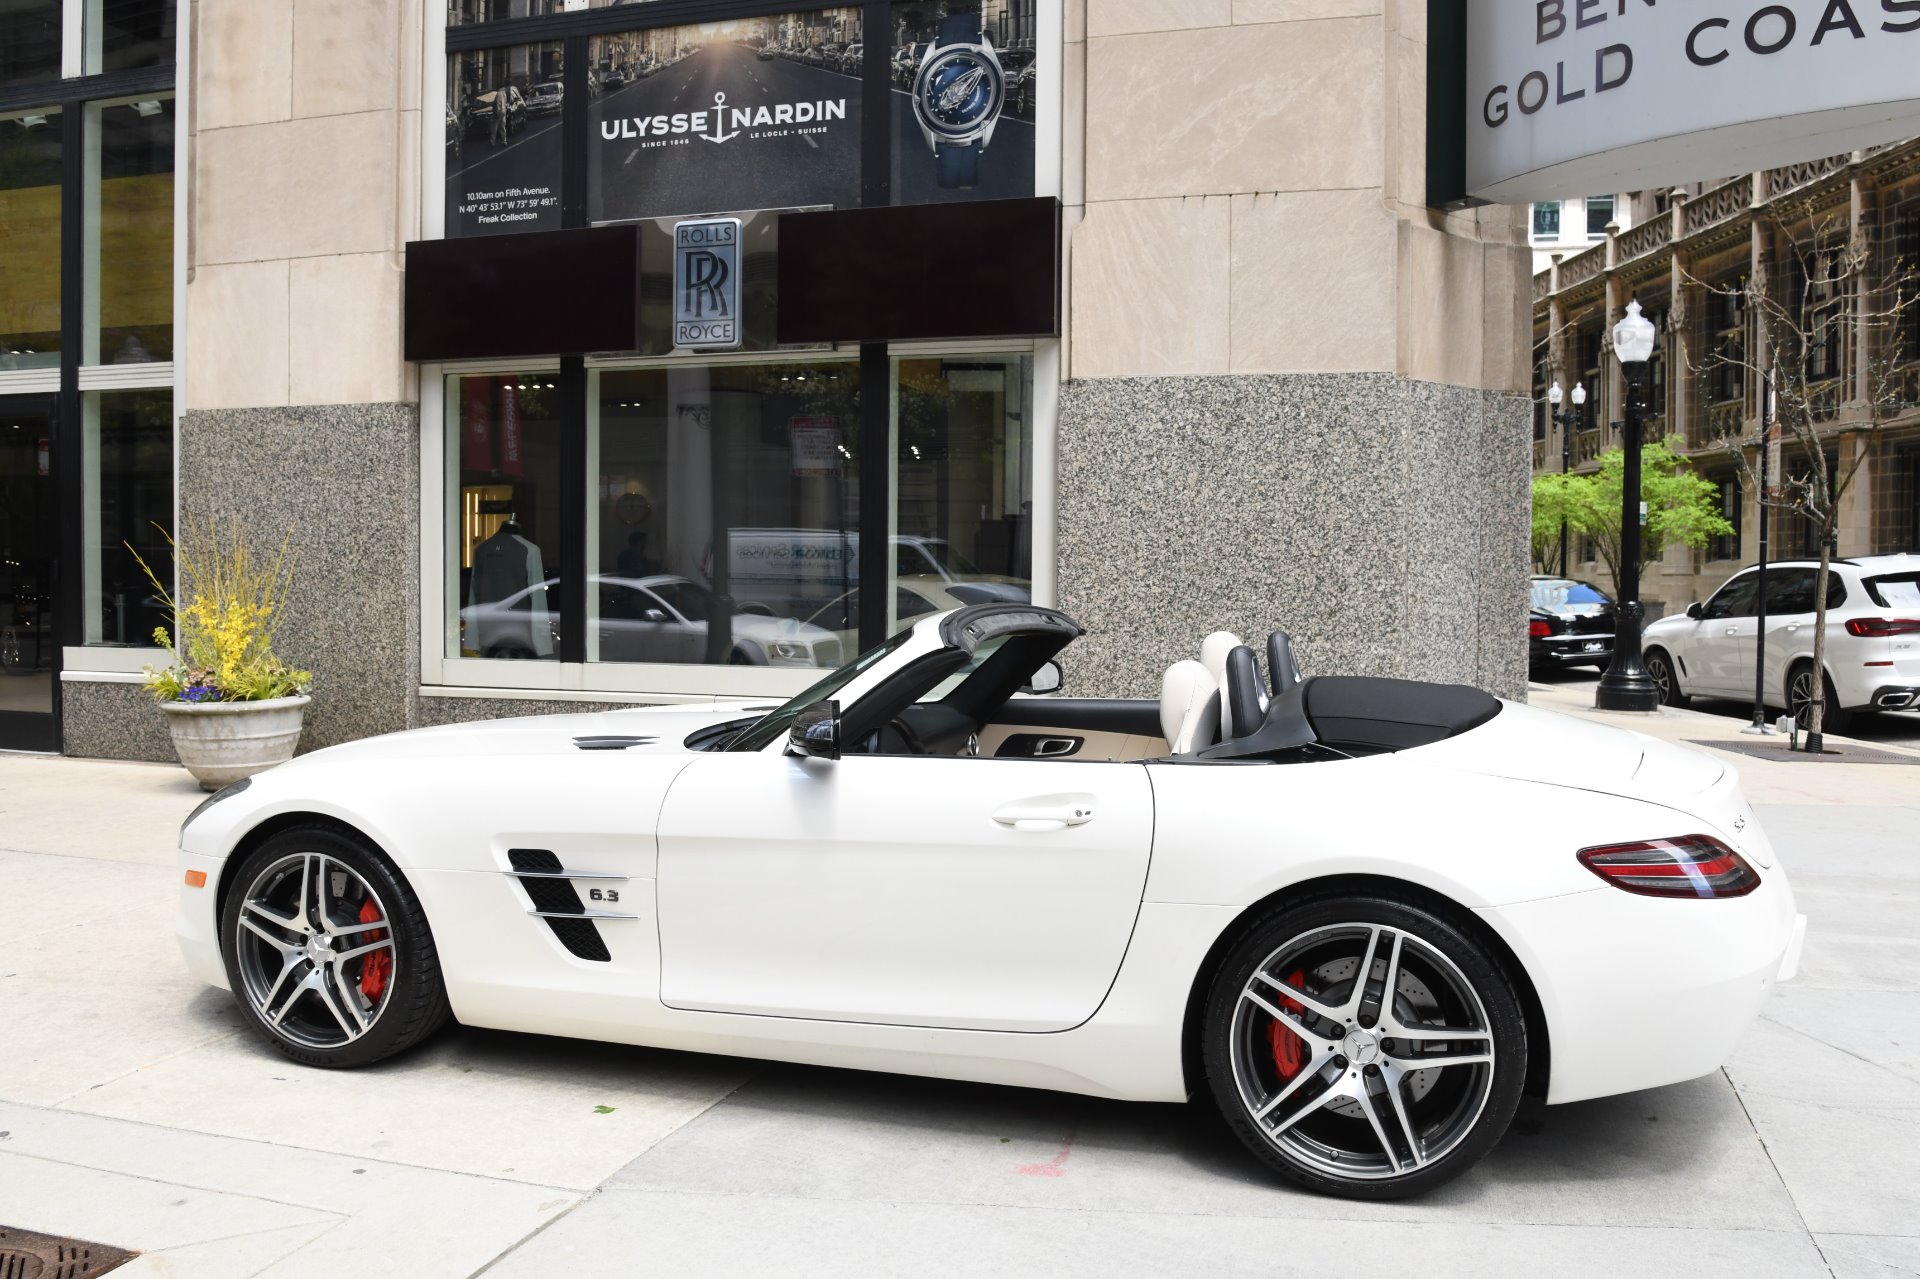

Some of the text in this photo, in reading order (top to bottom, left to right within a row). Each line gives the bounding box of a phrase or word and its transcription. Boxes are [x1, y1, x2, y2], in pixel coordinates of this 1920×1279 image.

[1483, 43, 1634, 129] GOLD
[601, 98, 846, 140] ULYSSE NARDIN
[762, 130, 788, 138] LOCLE
[798, 126, 828, 134] SUISSE
[641, 140, 667, 148] SINCE
[467, 187, 551, 201] 10.10am on Fifth Avenue.
[459, 205, 465, 213] N
[507, 201, 515, 209] W
[478, 212, 538, 224] Freak Collection
[681, 226, 732, 244] ROLLS
[684, 250, 729, 318] RR
[679, 323, 731, 340] ROYCE
[589, 888, 619, 903] 6.3
